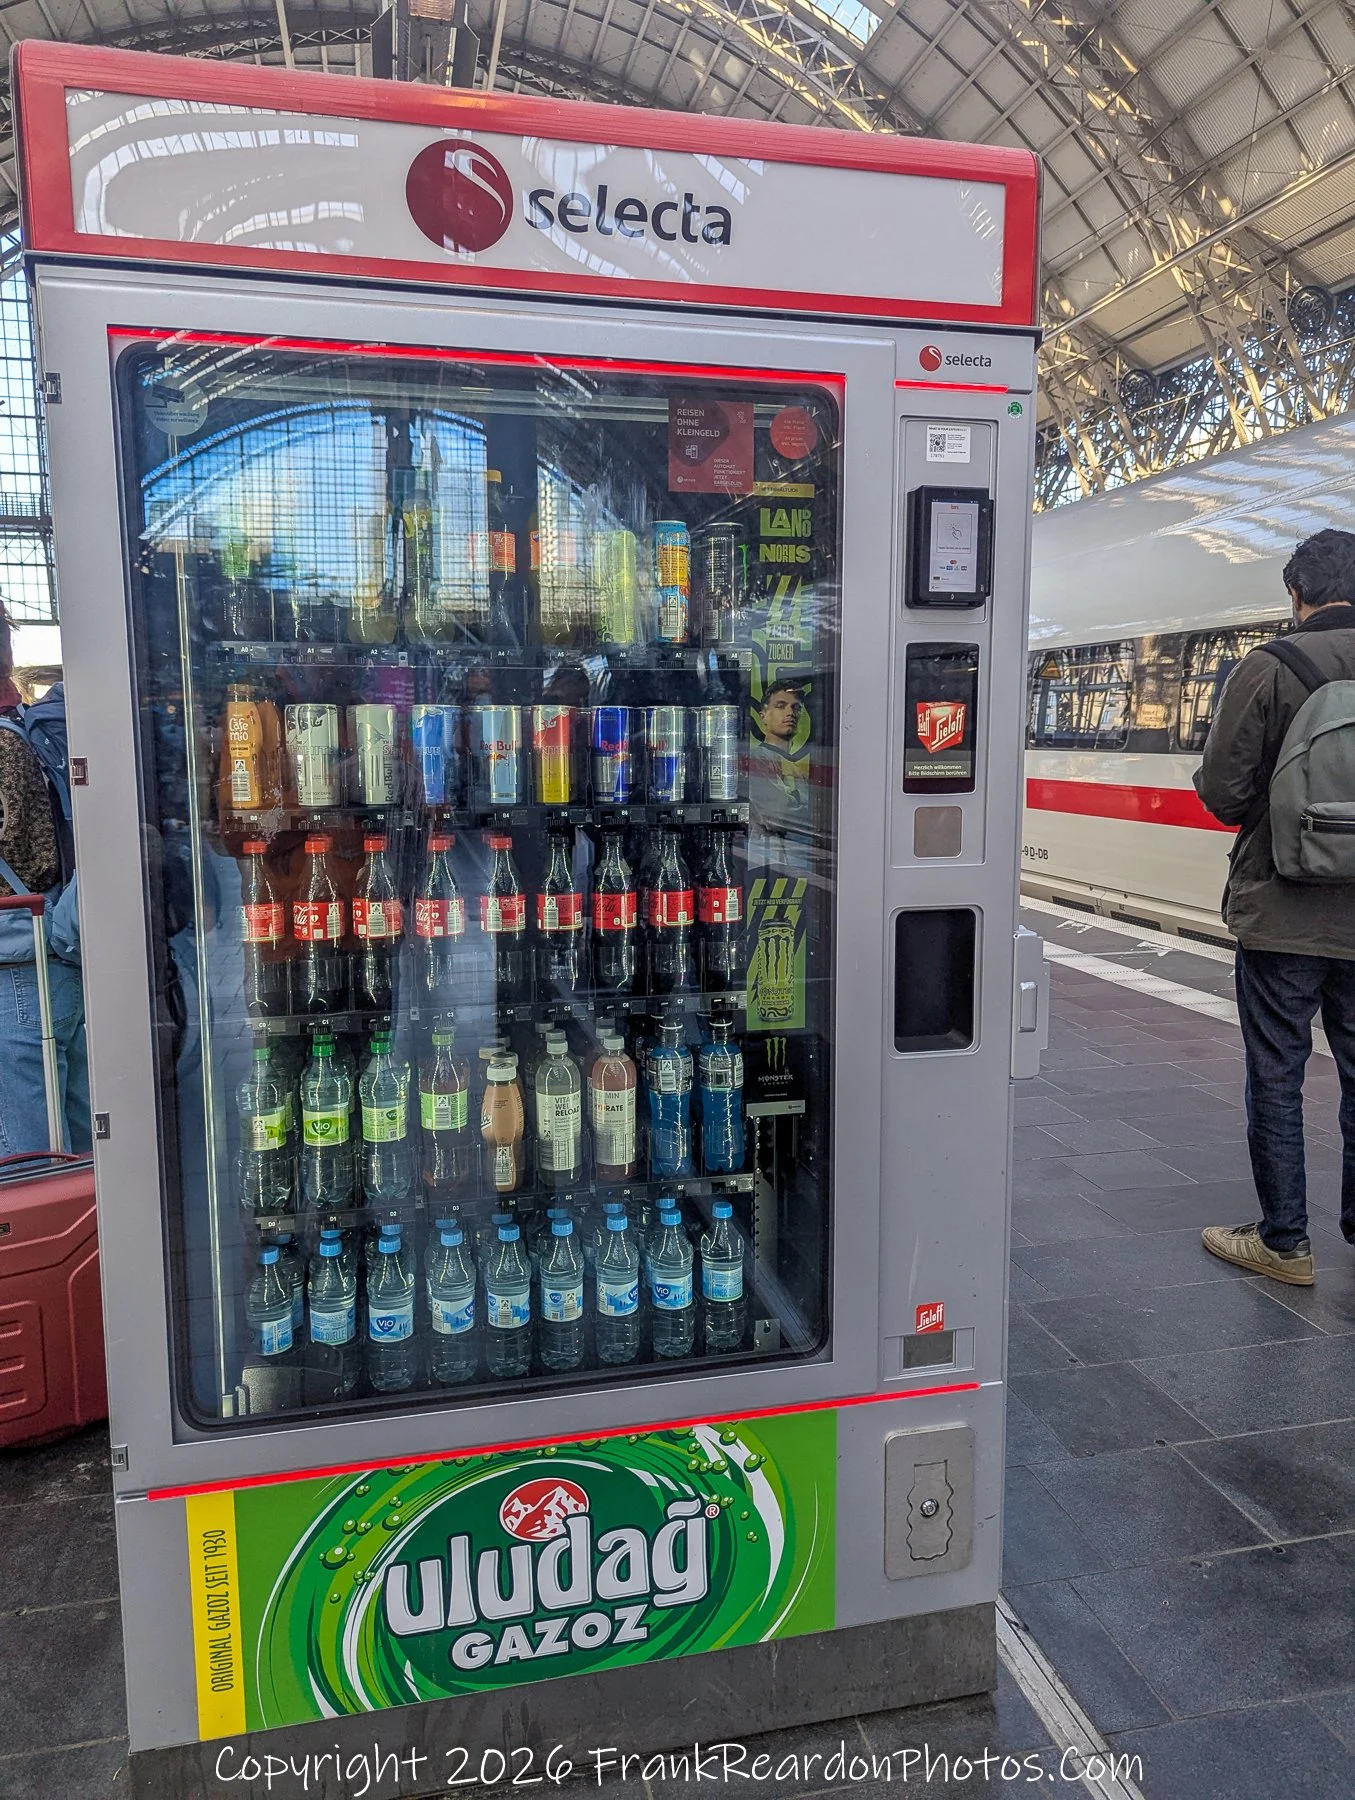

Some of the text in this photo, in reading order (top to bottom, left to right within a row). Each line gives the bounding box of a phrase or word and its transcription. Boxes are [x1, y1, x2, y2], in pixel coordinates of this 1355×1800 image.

[524, 184, 733, 246] selecta
[945, 353, 992, 368] selecta
[676, 408, 705, 417] REISEN
[676, 418, 700, 427] OHNE
[676, 428, 720, 438] KLEINGELD
[768, 643, 794, 661] ZUCKER
[230, 731, 249, 741] mio
[496, 740, 517, 751] Bull
[601, 740, 621, 751] Red
[383, 763, 393, 780] Bull
[384, 780, 393, 802] Red
[758, 1074, 794, 1083] MONSTER
[386, 1498, 708, 1636] uludağ
[202, 1528, 235, 1693] ORIGINAL GAZOZ SEIT 1930
[451, 1604, 649, 1670] GAZOZ
